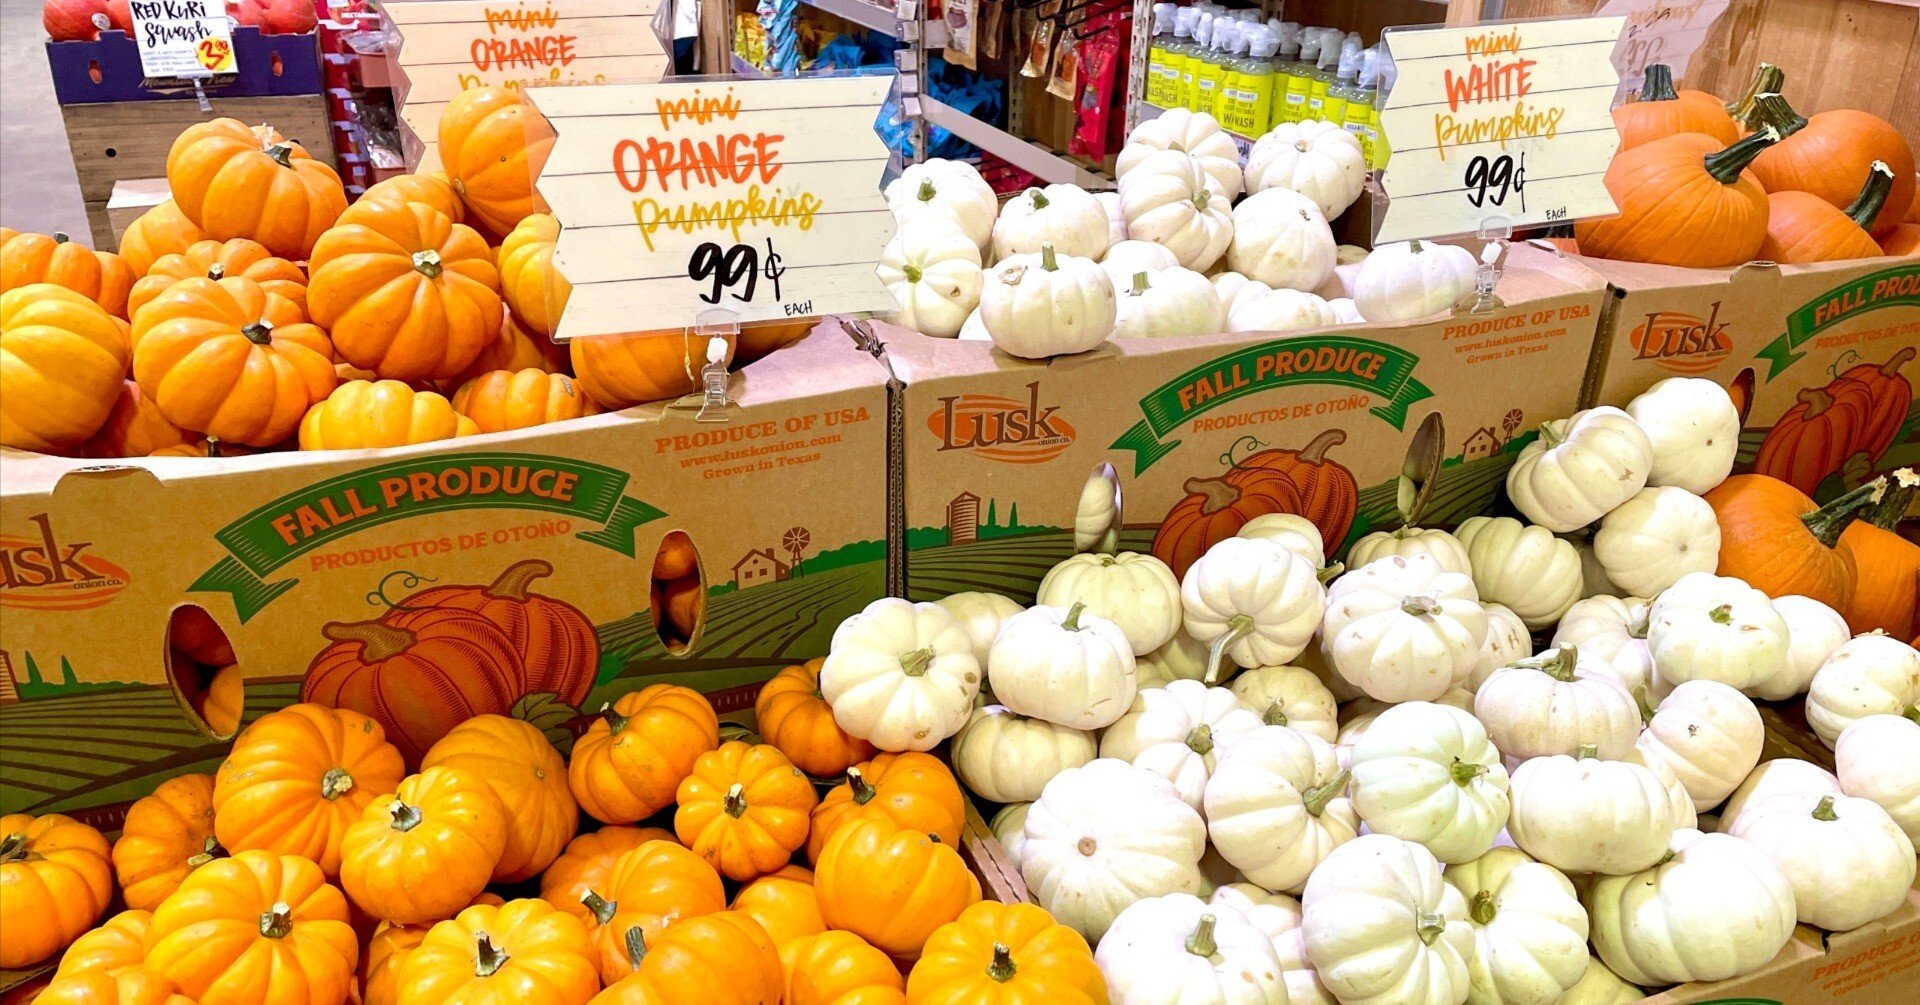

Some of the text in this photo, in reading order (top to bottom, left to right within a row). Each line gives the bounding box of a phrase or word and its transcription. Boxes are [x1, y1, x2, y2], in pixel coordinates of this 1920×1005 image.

[131, 1, 161, 20] RED
[484, 1, 558, 34] mini
[470, 35, 577, 72] ORANGE
[1466, 26, 1522, 61] mini
[656, 86, 742, 131] mini
[612, 132, 785, 193] ORANGE
[1546, 206, 1566, 220] EACH
[784, 300, 813, 316] EACH
[1815, 274, 1920, 327] FALL PROD
[1442, 304, 1590, 341] PRODUCE OF USA
[1454, 327, 1566, 354] www.luskonion.com
[1632, 300, 1730, 360] Lusk
[1467, 342, 1549, 365] Grown in Texas
[1177, 346, 1386, 412] FALL PRODUCE
[654, 406, 870, 454] PRODUCE OF USA
[937, 380, 1060, 452] Lusk
[1192, 394, 1370, 434] PRODUCTOS DE OTOÑO
[680, 433, 842, 469] www.luskonion.com
[1037, 437, 1059, 446] onion
[702, 452, 821, 480] Grown in Texas
[271, 466, 580, 546] FALL PRODUCE
[0, 512, 105, 590] sk
[309, 519, 571, 572] PRODUCTOS DE OTOÑO
[74, 580, 106, 590] onion
